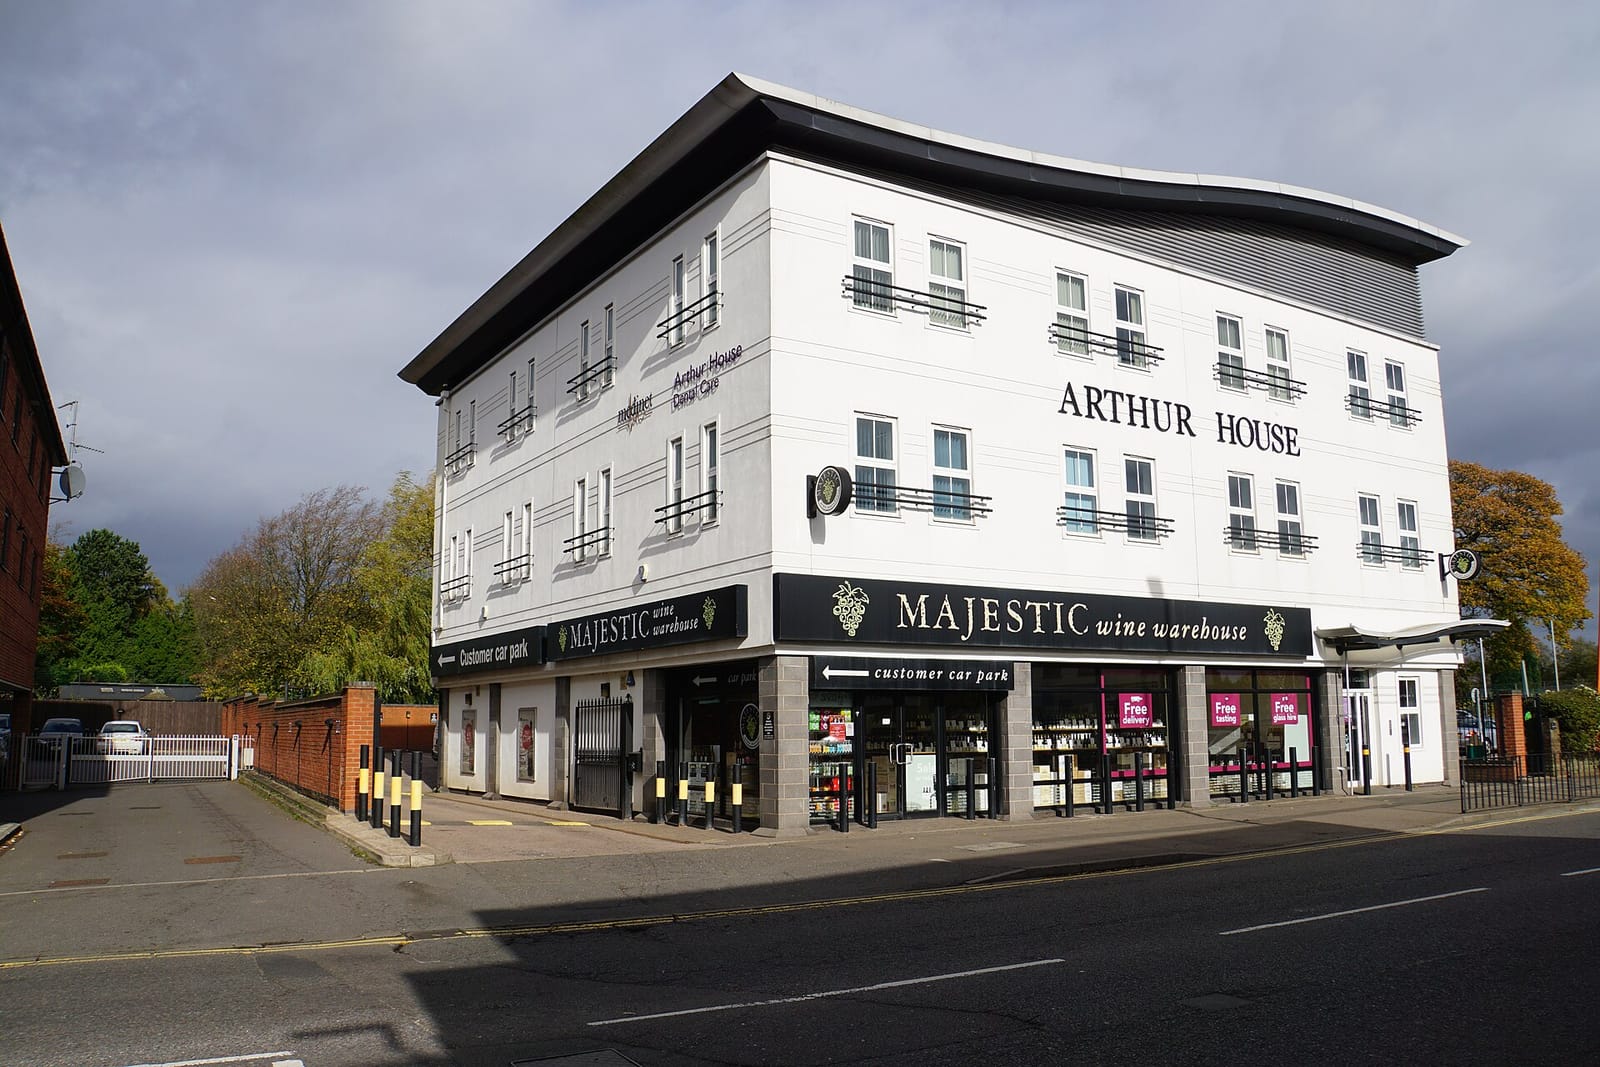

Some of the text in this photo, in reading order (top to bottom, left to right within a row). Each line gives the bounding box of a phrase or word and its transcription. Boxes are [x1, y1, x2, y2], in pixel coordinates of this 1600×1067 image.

[673, 344, 743, 390] Arthur House
[672, 377, 720, 408] Dental Care
[1058, 381, 1301, 457] ARTHUR HOUSE
[653, 602, 675, 618] wine
[896, 593, 1247, 641] MAJESTIC wine warehouse
[570, 610, 699, 653] MAJESTIC warehouse
[460, 638, 529, 667] Customer car park
[874, 667, 1009, 684] customer car park
[1124, 702, 1148, 715] Free
[1215, 702, 1237, 713] Free
[1275, 702, 1294, 712] Free
[1122, 715, 1150, 726] delivery
[1215, 714, 1237, 724] tasting
[1286, 713, 1297, 721] hire
